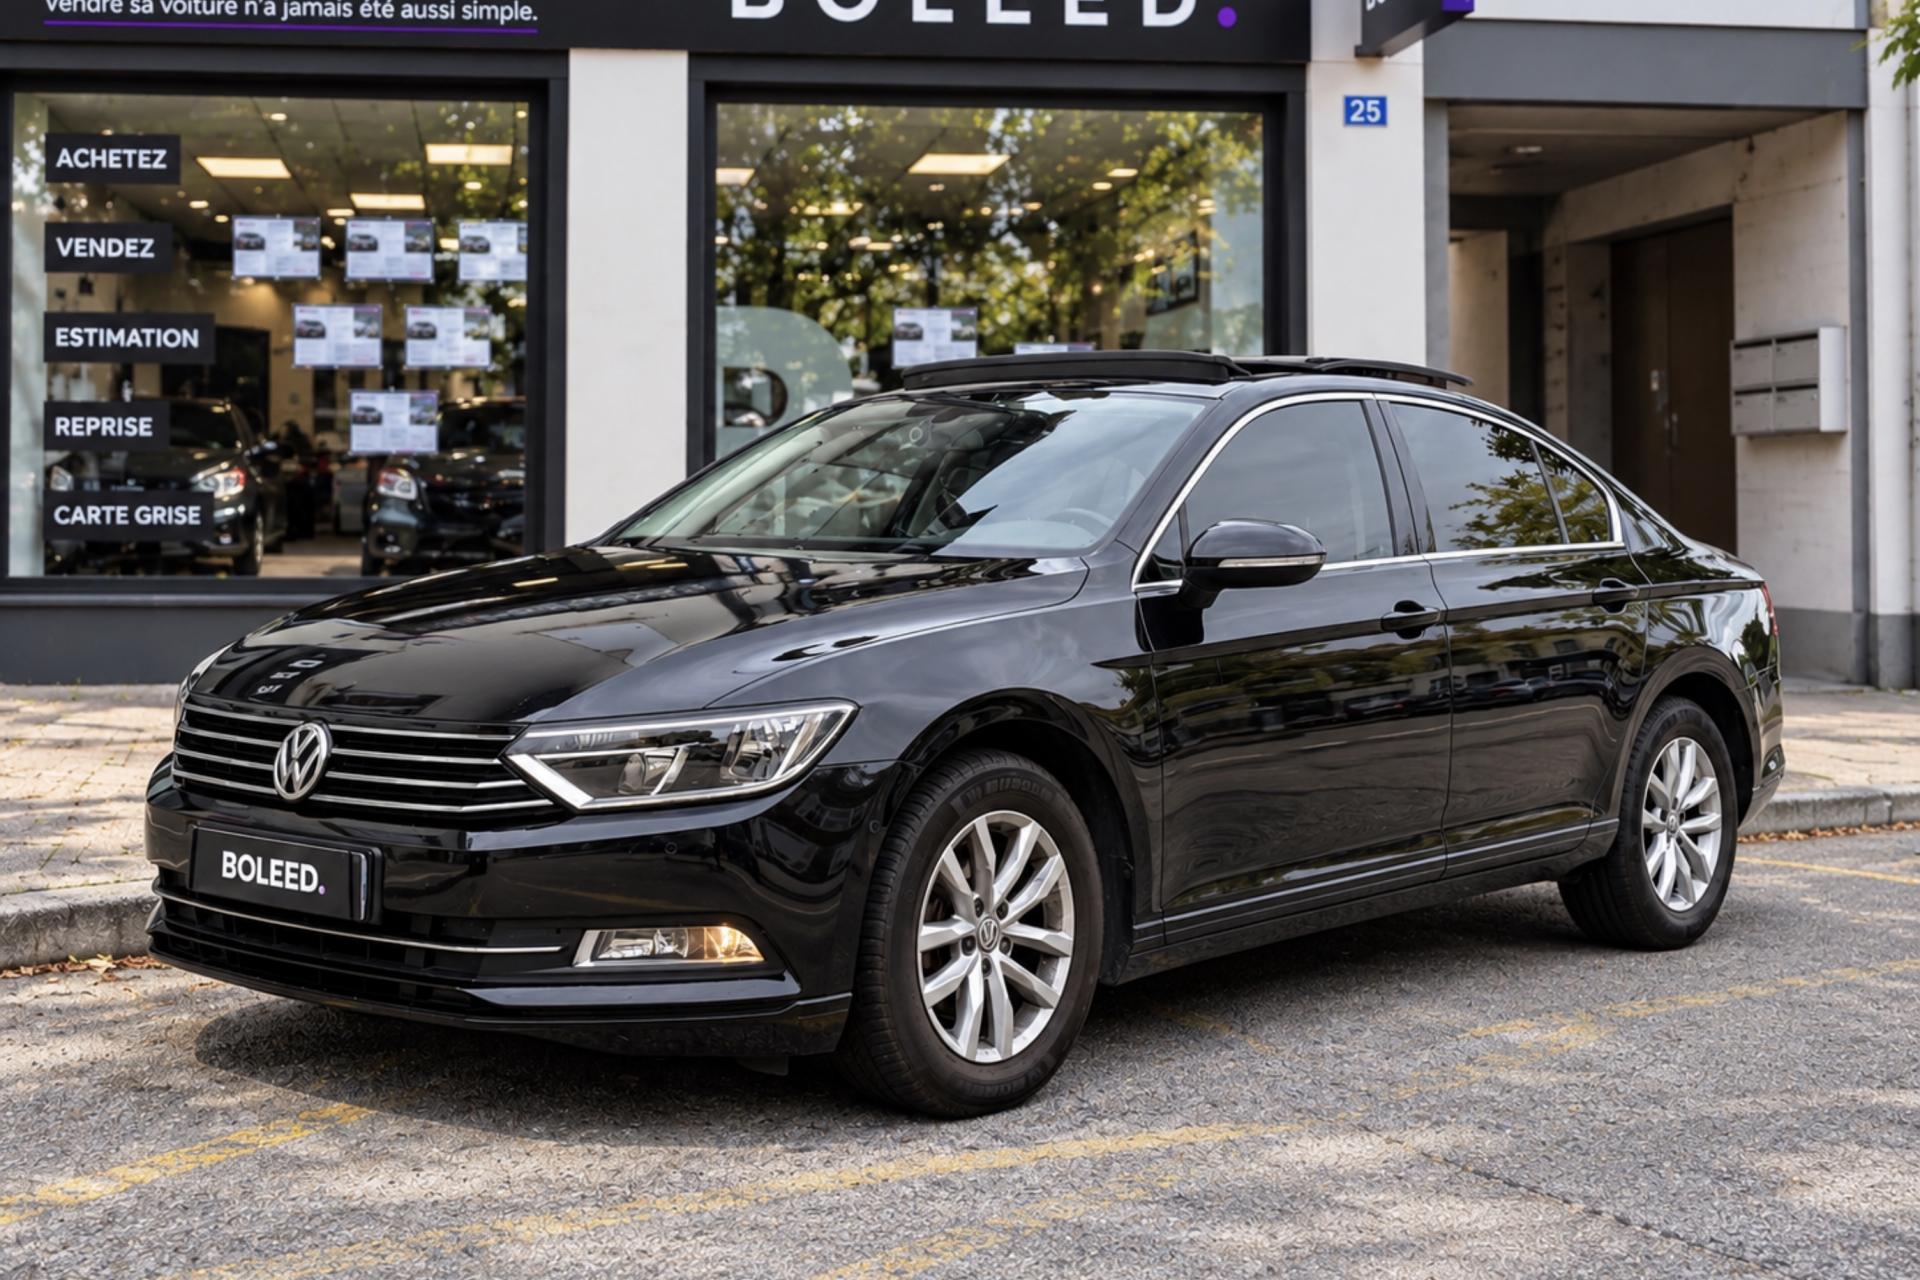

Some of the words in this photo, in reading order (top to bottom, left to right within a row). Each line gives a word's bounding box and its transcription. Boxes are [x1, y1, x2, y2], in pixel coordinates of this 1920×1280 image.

[130, 0, 154, 14] sa
[160, 0, 238, 15] voiture
[280, 0, 353, 21] jamais
[359, 0, 395, 18] été
[401, 0, 455, 19] aussi
[462, 0, 538, 25] simple.
[1351, 99, 1381, 122] 25
[56, 148, 167, 169] ACHETEZ
[56, 237, 155, 258] VENDEZ
[55, 328, 199, 348] ESTIMATION
[55, 417, 153, 437] REPRISE
[54, 506, 129, 525] CARTE
[135, 506, 201, 525] GRISE
